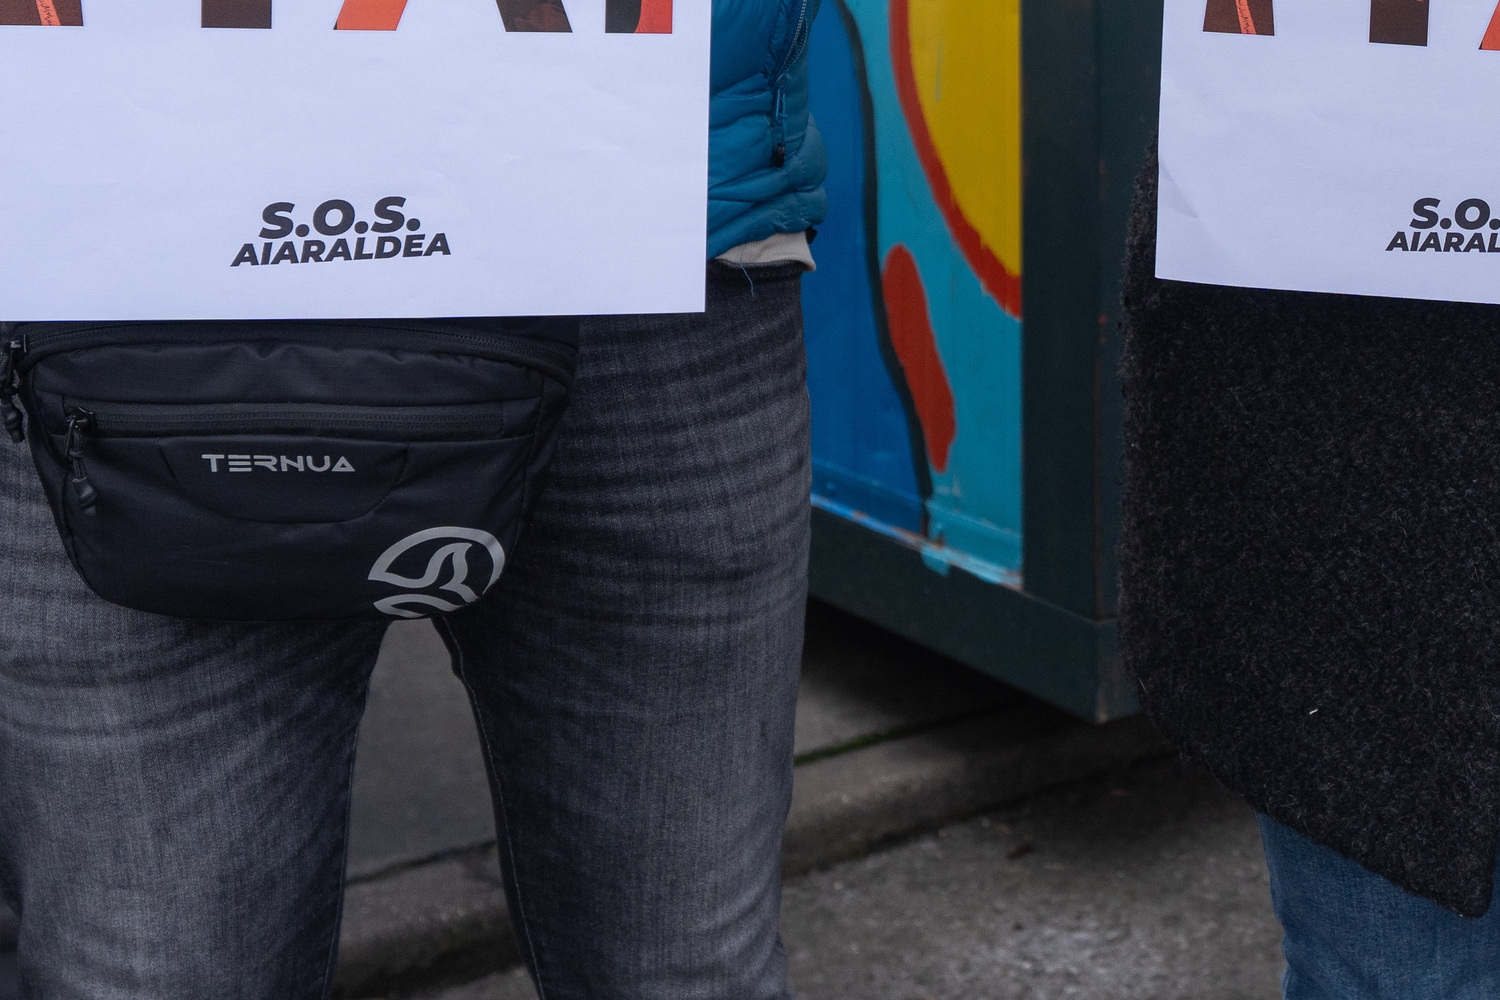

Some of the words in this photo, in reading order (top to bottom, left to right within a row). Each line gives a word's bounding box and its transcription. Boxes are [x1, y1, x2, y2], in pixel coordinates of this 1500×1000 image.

[259, 197, 420, 239] S.O.S.
[230, 233, 451, 267] AIARALDEA
[201, 454, 355, 473] TERNUA
